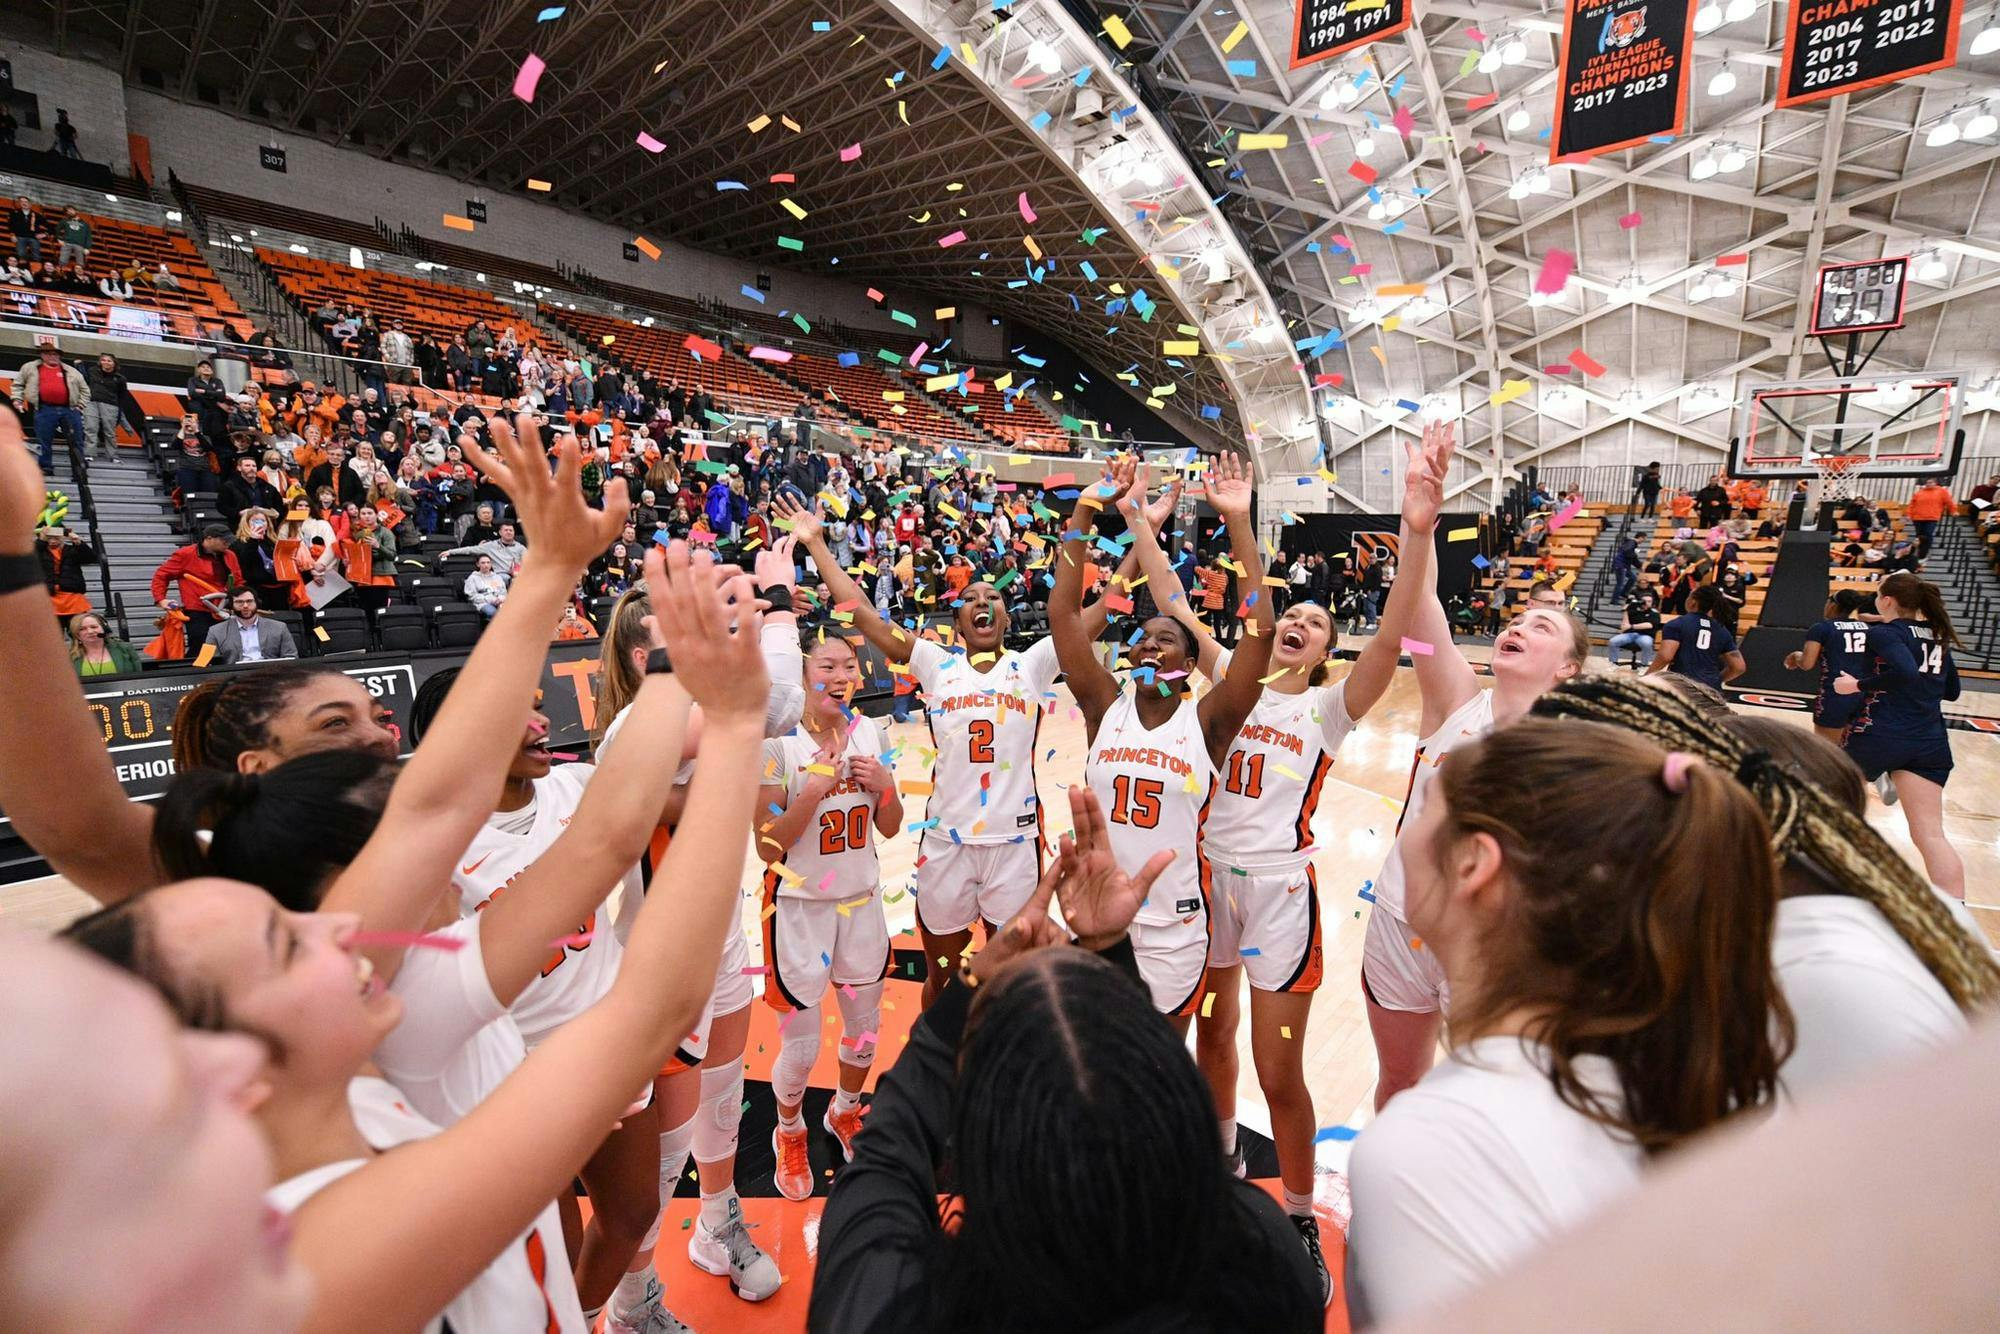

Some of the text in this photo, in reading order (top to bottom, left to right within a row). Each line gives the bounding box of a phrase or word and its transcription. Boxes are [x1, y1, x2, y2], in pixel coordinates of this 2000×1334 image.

[1308, 3, 1391, 48] 1990 1991
[1311, 2, 1346, 27] 1984
[1808, 0, 1936, 46] 2004 2011
[1588, 38, 1662, 68] IVY LEAGUE
[1805, 18, 1935, 67] 2017 2022
[1570, 55, 1675, 95] CHAMPIONS
[1580, 46, 1667, 79] TOURNAMENT
[1803, 61, 1859, 88] 2023
[1573, 73, 1668, 112] 2017 2023
[264, 153, 284, 167] 307
[1696, 629, 1711, 650] 0
[1843, 632, 1866, 653] 12
[1918, 642, 1943, 675] 14
[127, 684, 194, 697] DAKTRONICS
[968, 719, 994, 763] 2
[1096, 746, 1192, 777] PRINCETON
[1225, 749, 1265, 800] 11
[1111, 774, 1164, 829] 15
[819, 804, 870, 855] 20
